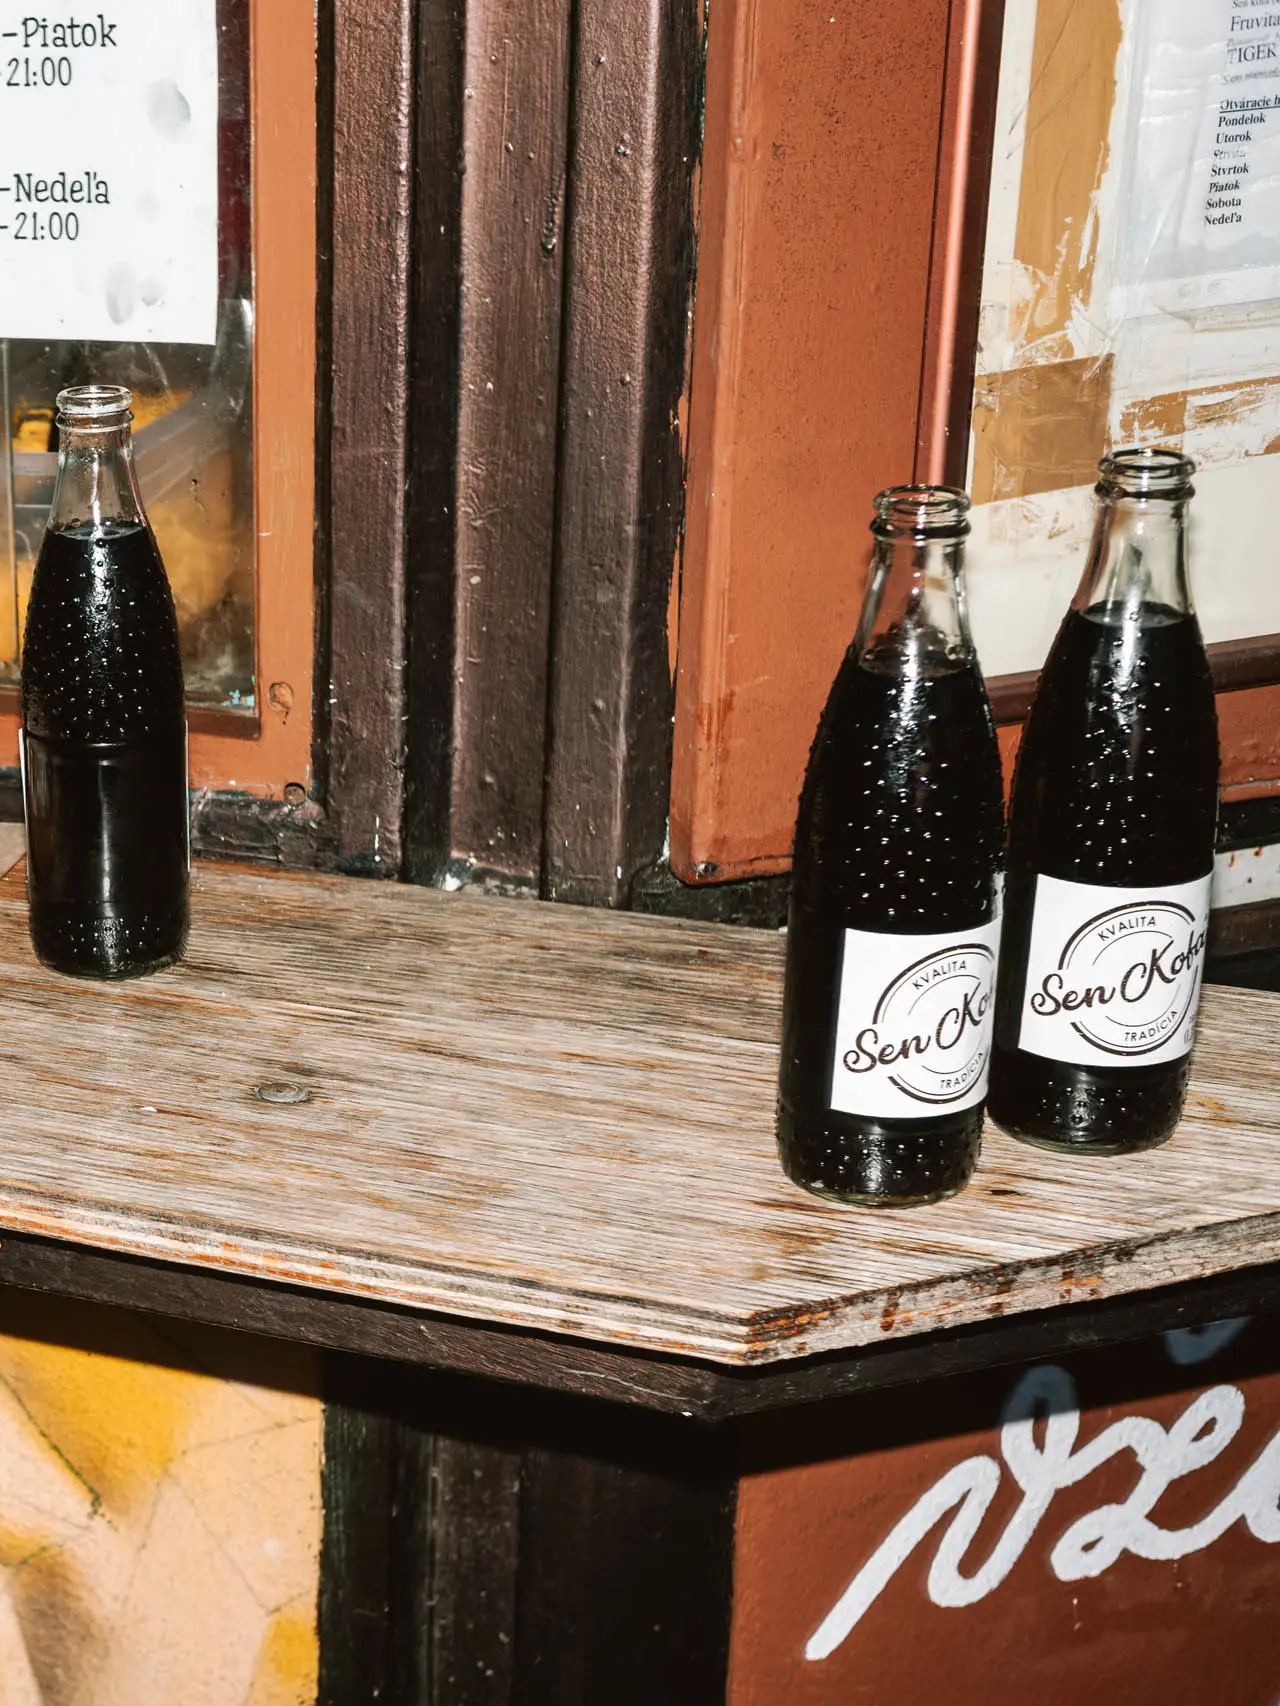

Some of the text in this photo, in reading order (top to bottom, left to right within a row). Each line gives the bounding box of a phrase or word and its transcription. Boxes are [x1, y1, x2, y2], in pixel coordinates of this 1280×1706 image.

[1227, 42, 1277, 64] TIGER
[1218, 112, 1266, 127] Pondelok
[1216, 131, 1252, 144] Utorok
[1209, 180, 1240, 193] Piatok
[1205, 197, 1242, 210] Sobota
[1098, 916, 1156, 941] KVALITA
[912, 960, 967, 990] KVALITA
[1031, 973, 1116, 1016] Sen
[843, 1028, 931, 1073] Sen
